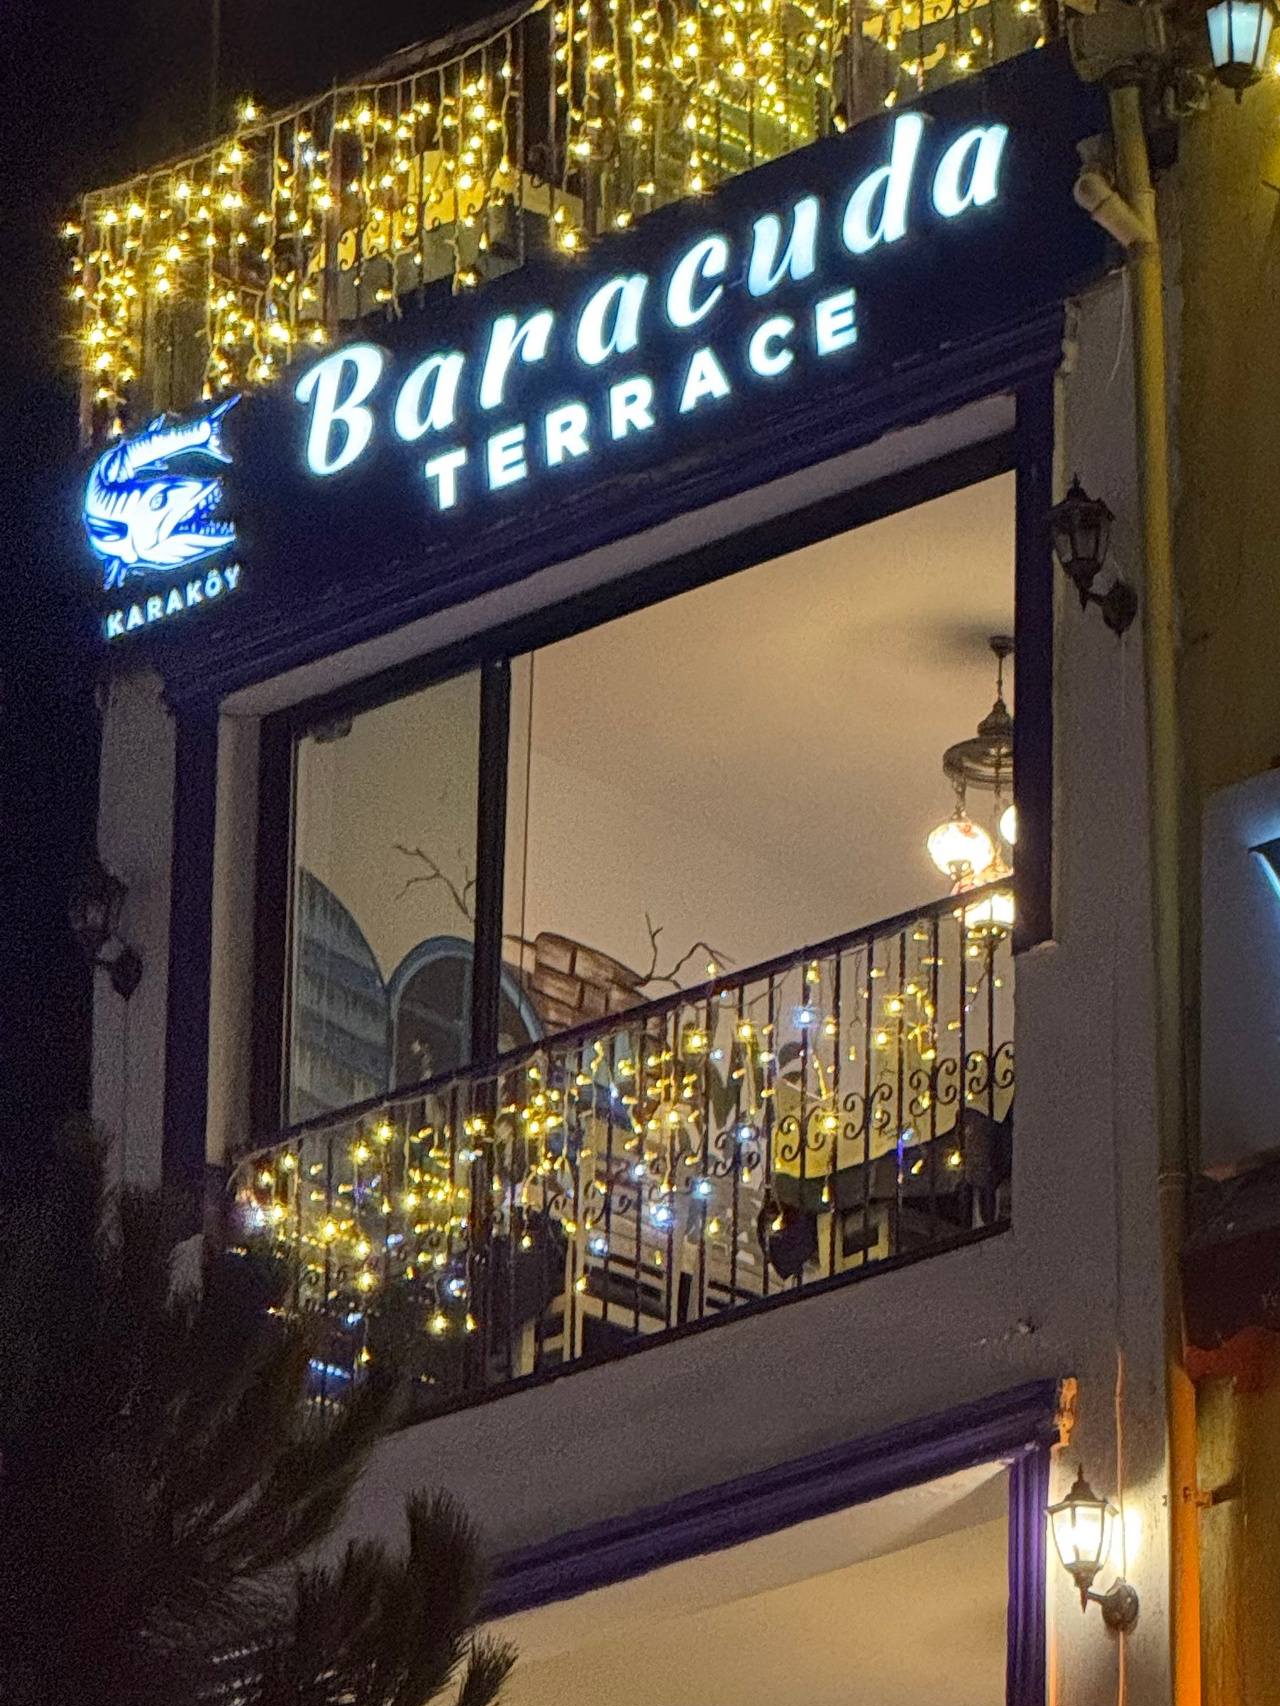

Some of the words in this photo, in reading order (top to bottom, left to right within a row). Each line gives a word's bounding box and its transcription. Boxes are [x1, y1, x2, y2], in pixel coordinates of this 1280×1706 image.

[295, 111, 1010, 477] Baracuda
[425, 288, 862, 512] TERRACE
[105, 565, 242, 640] KARAKÖY
